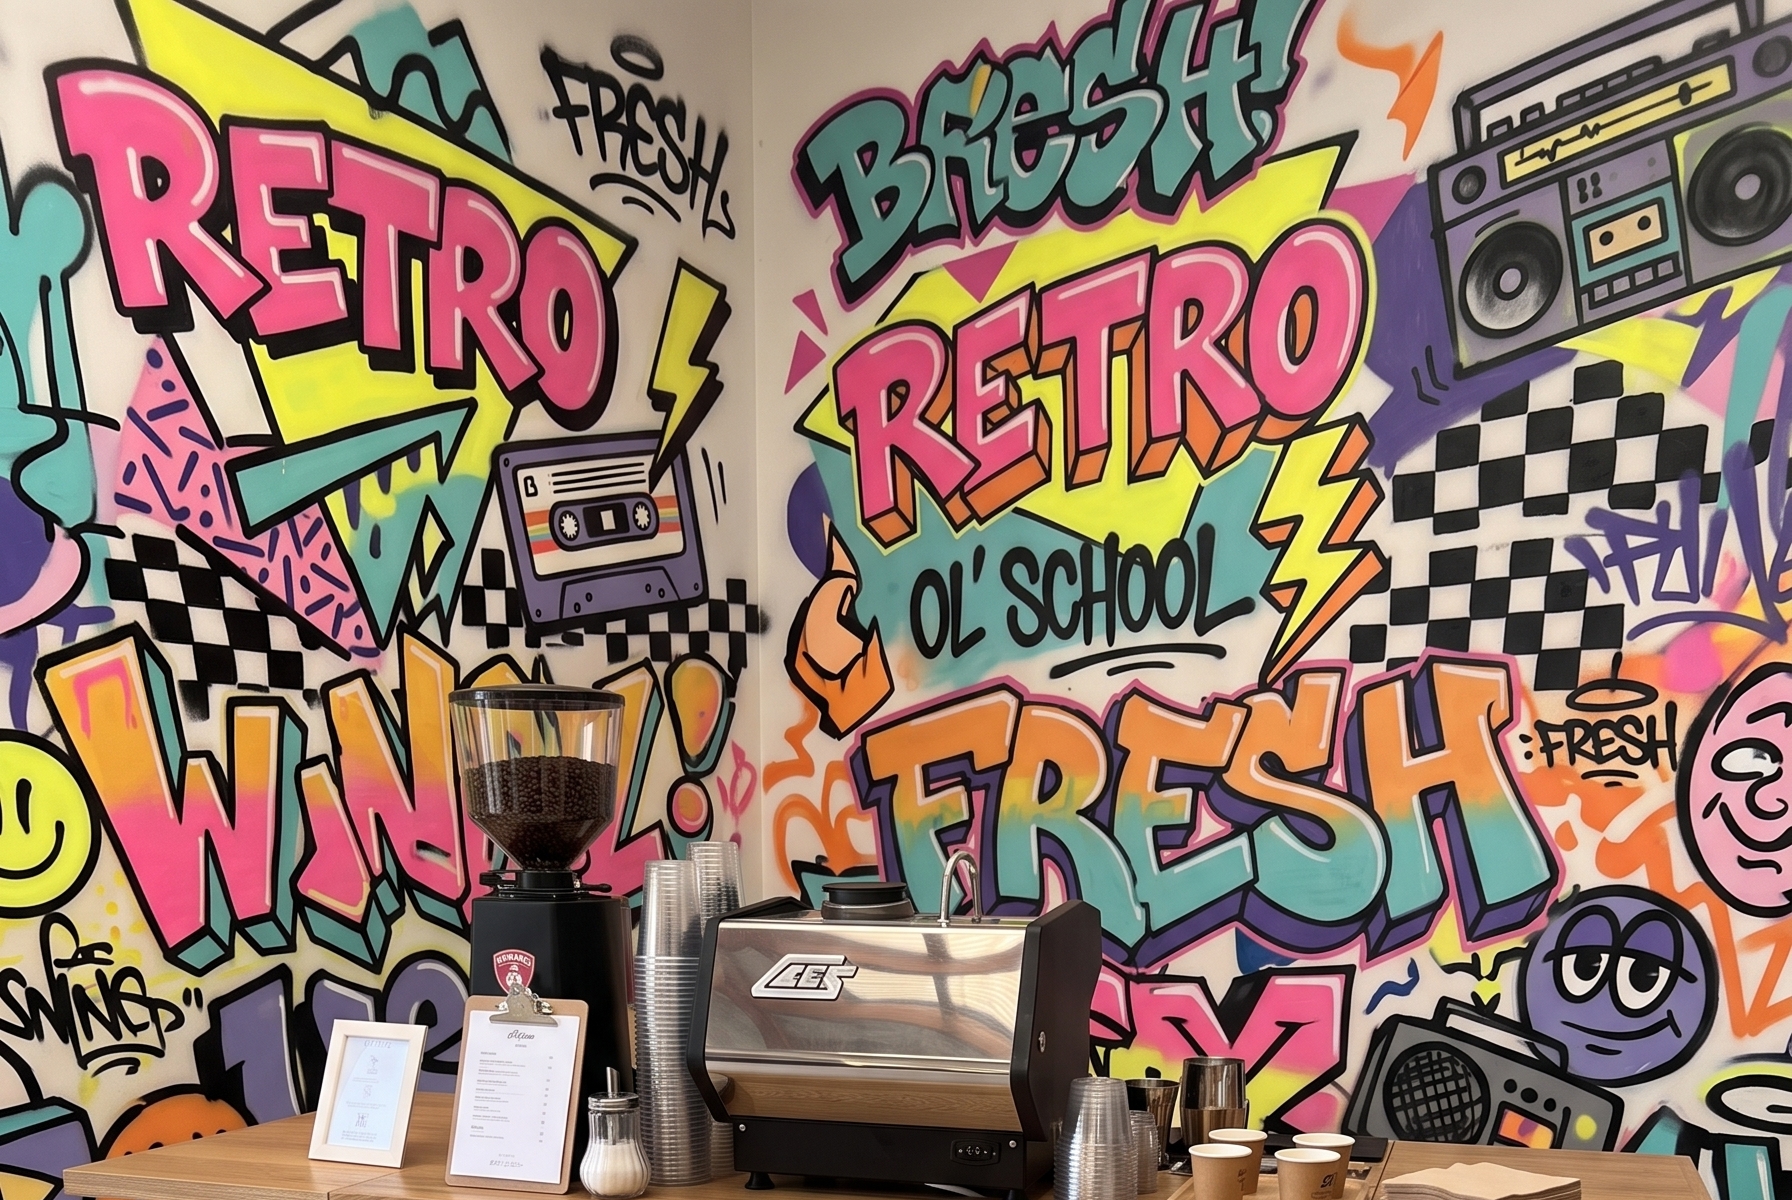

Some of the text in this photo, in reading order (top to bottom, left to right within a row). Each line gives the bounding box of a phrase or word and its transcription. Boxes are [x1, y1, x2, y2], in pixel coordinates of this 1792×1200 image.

[43, 58, 618, 431] RETRO
[540, 46, 735, 239] FRESH
[832, 216, 1371, 550] RETRO
[910, 523, 1256, 658] OL' SCHOOL
[850, 655, 1562, 966] FRESH
